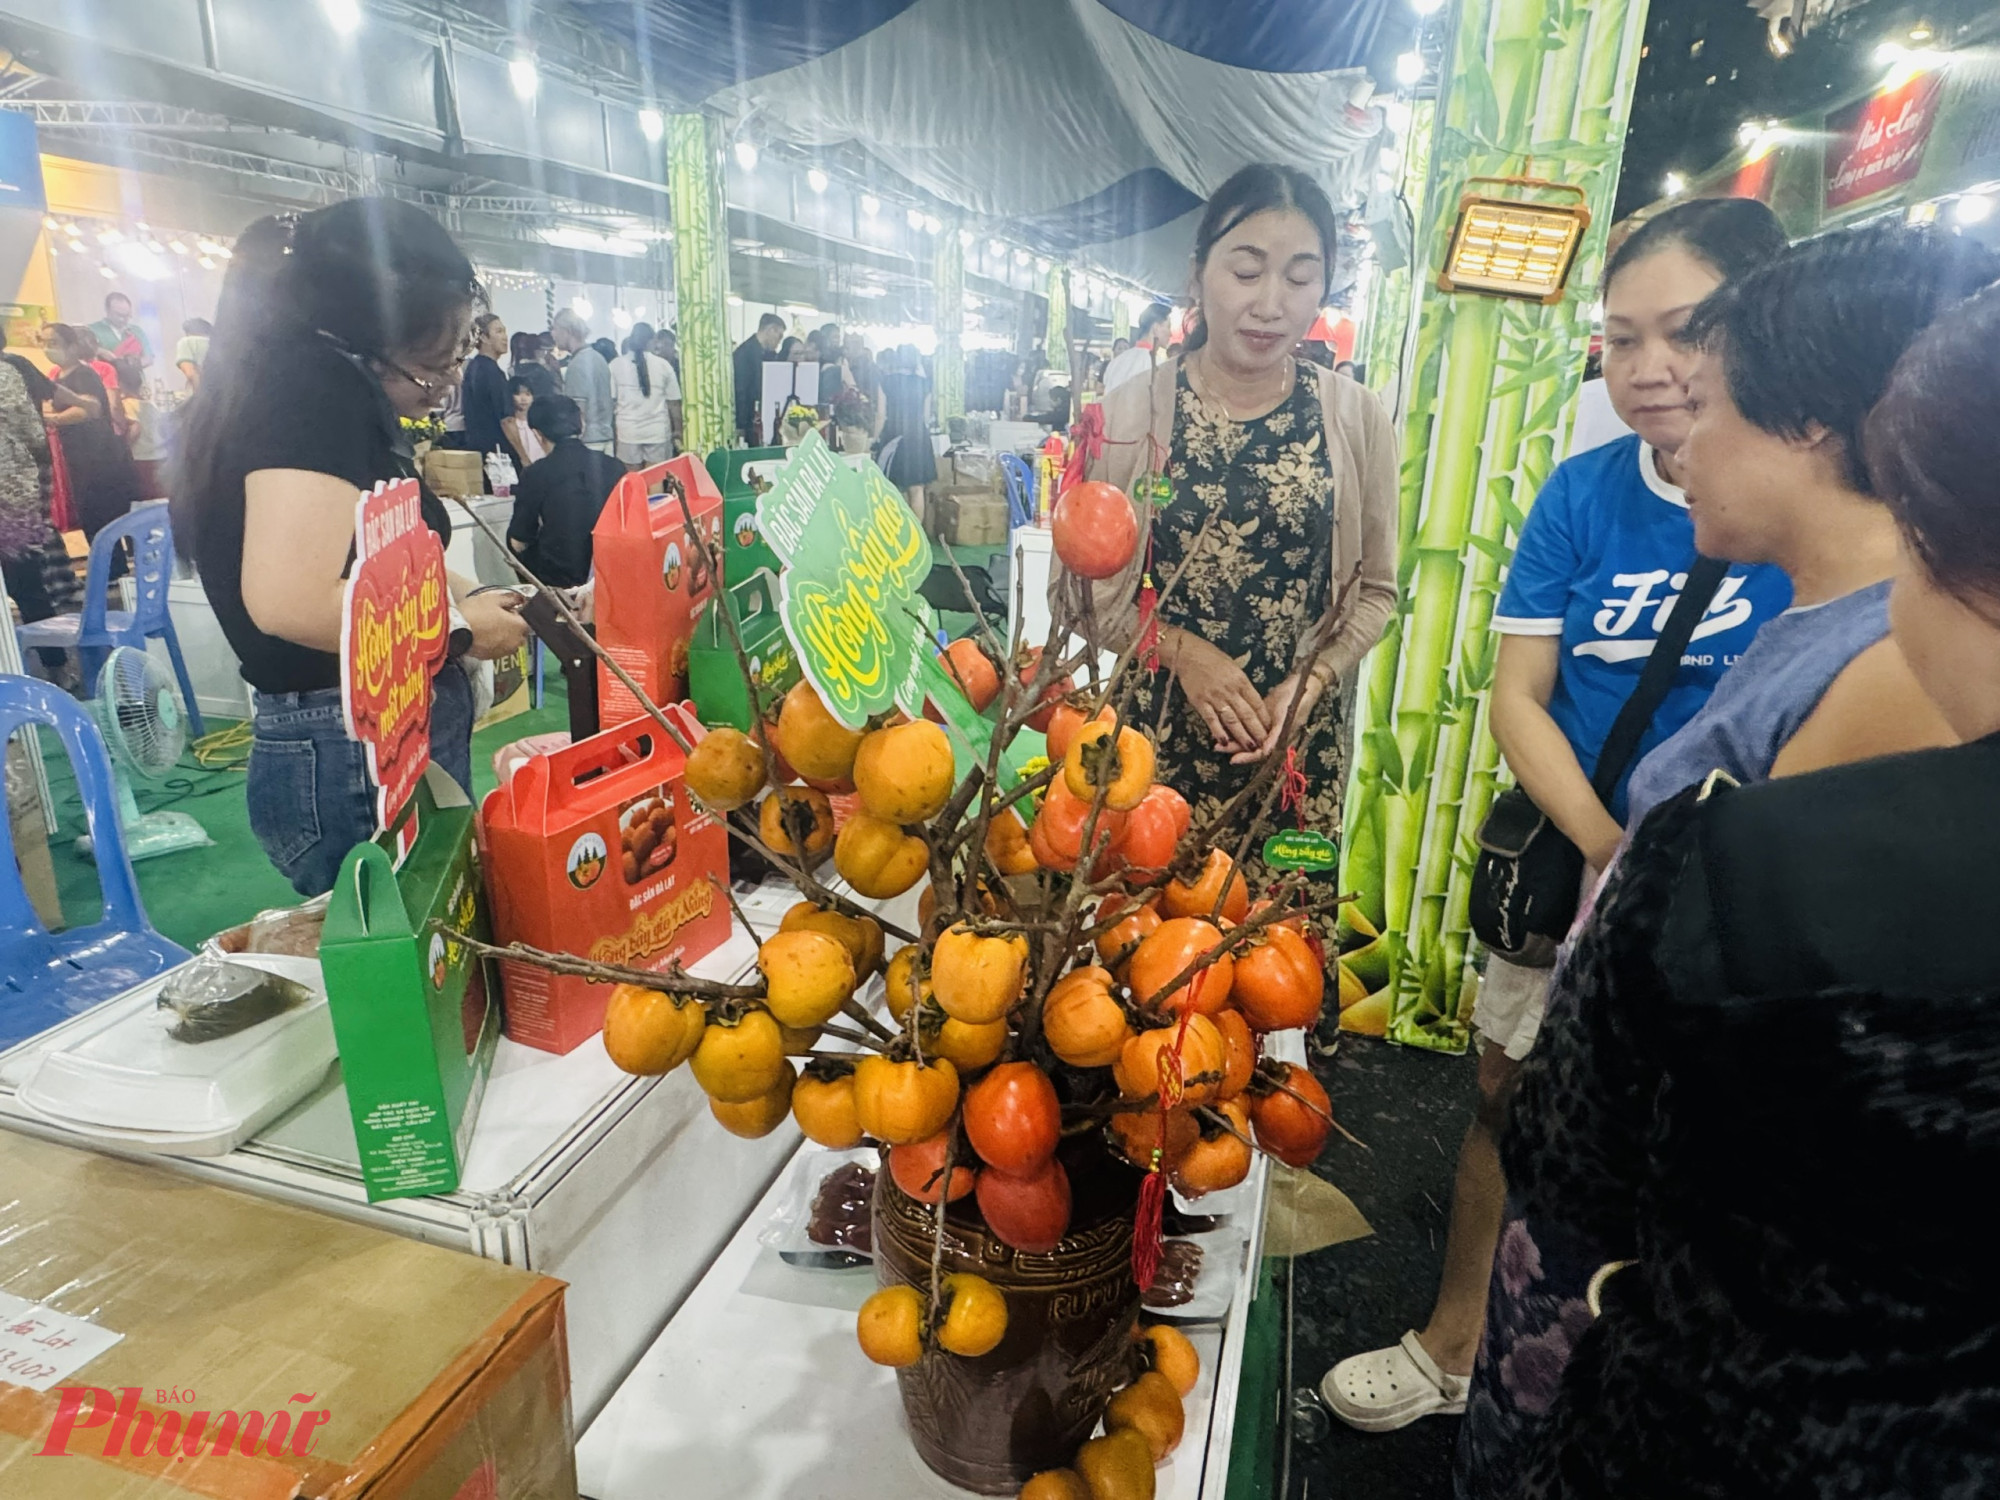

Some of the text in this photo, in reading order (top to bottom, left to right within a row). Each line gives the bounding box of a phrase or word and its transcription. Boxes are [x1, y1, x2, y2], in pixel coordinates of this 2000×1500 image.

[770, 438, 837, 555] ĐẶC SẢN ĐÀ LẠT
[356, 597, 393, 697] Hồng
[805, 578, 888, 701] Hồng
